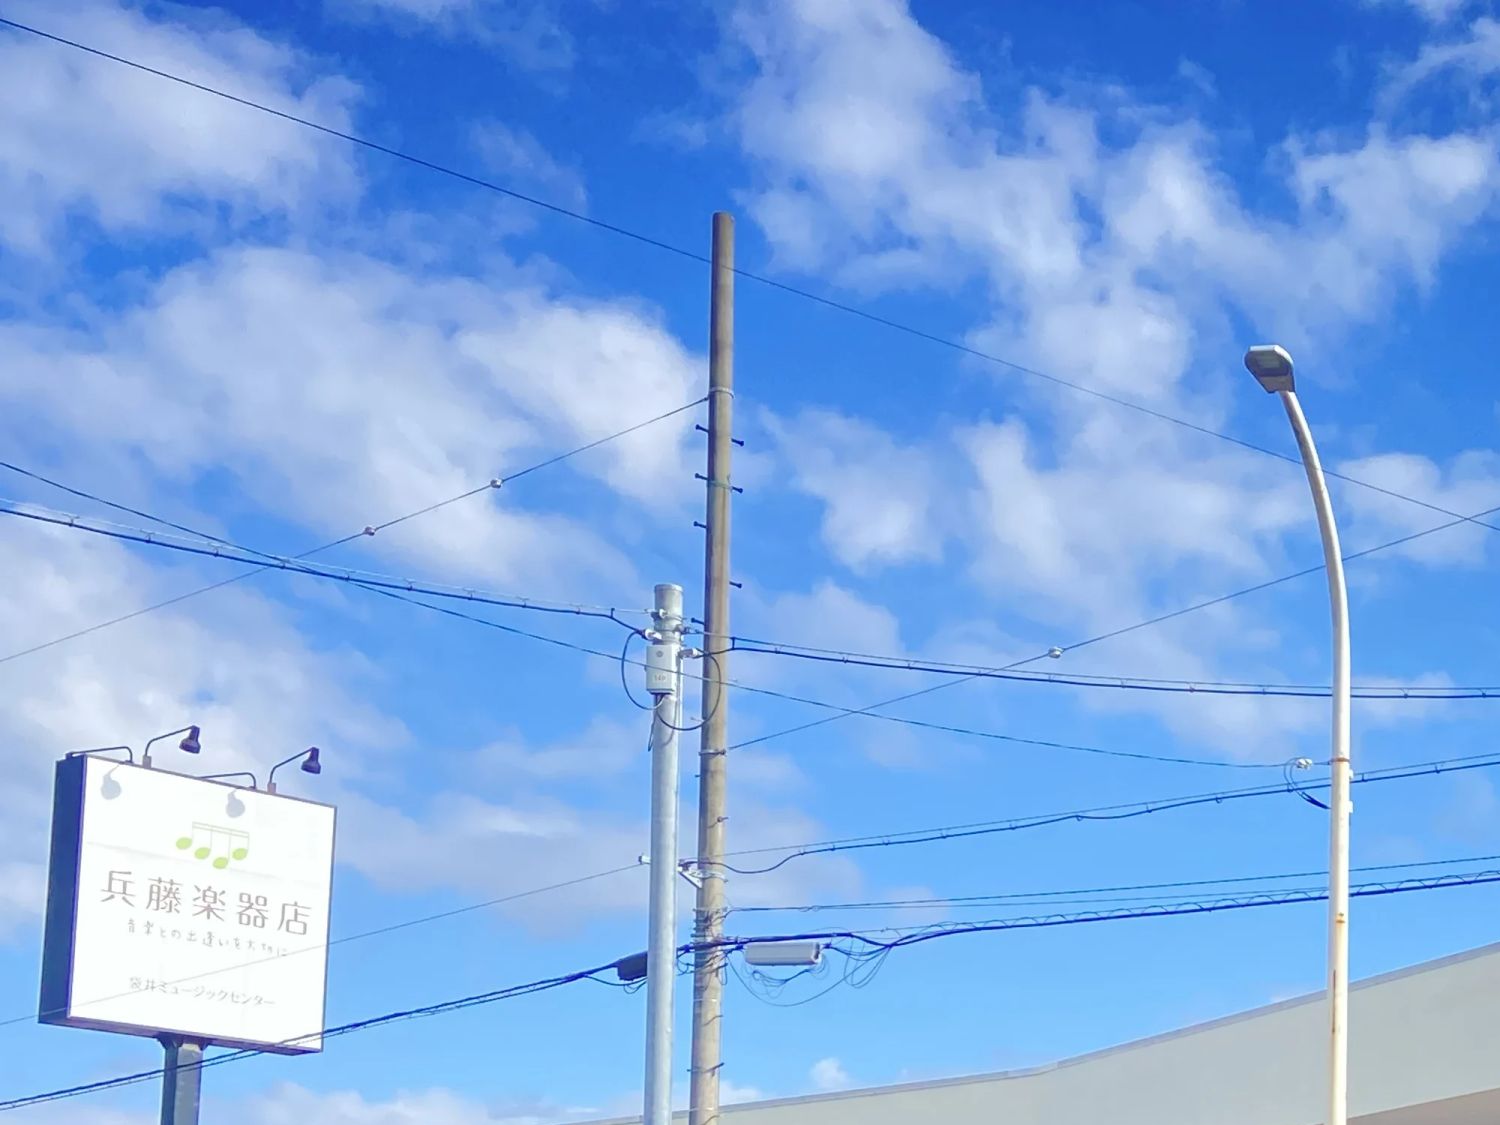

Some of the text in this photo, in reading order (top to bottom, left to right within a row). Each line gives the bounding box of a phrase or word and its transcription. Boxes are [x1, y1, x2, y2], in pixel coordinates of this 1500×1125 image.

[100, 869, 312, 936] 兵藤楽器店
